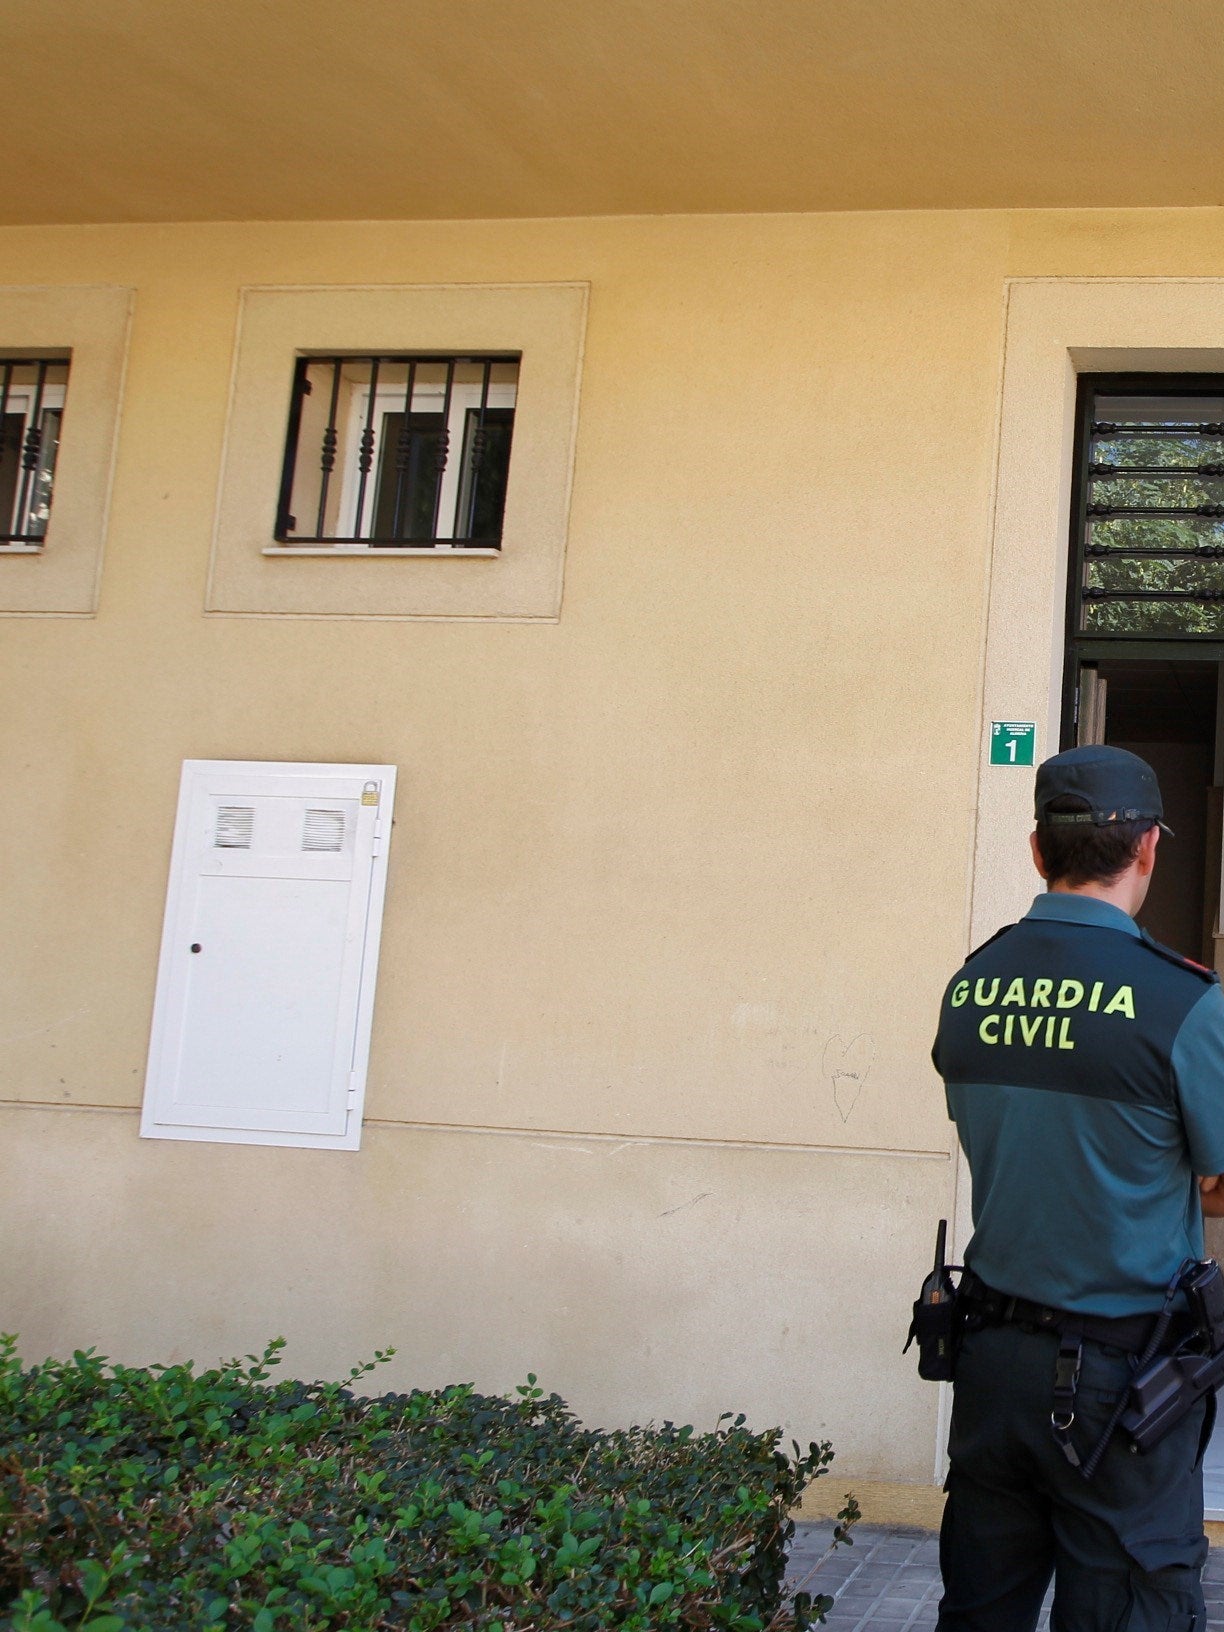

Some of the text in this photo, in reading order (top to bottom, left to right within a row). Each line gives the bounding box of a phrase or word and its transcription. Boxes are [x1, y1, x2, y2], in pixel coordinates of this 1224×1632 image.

[1005, 739, 1017, 762] 1
[951, 977, 1136, 1020] GUARDIA
[978, 1014, 1075, 1050] CIVIL
